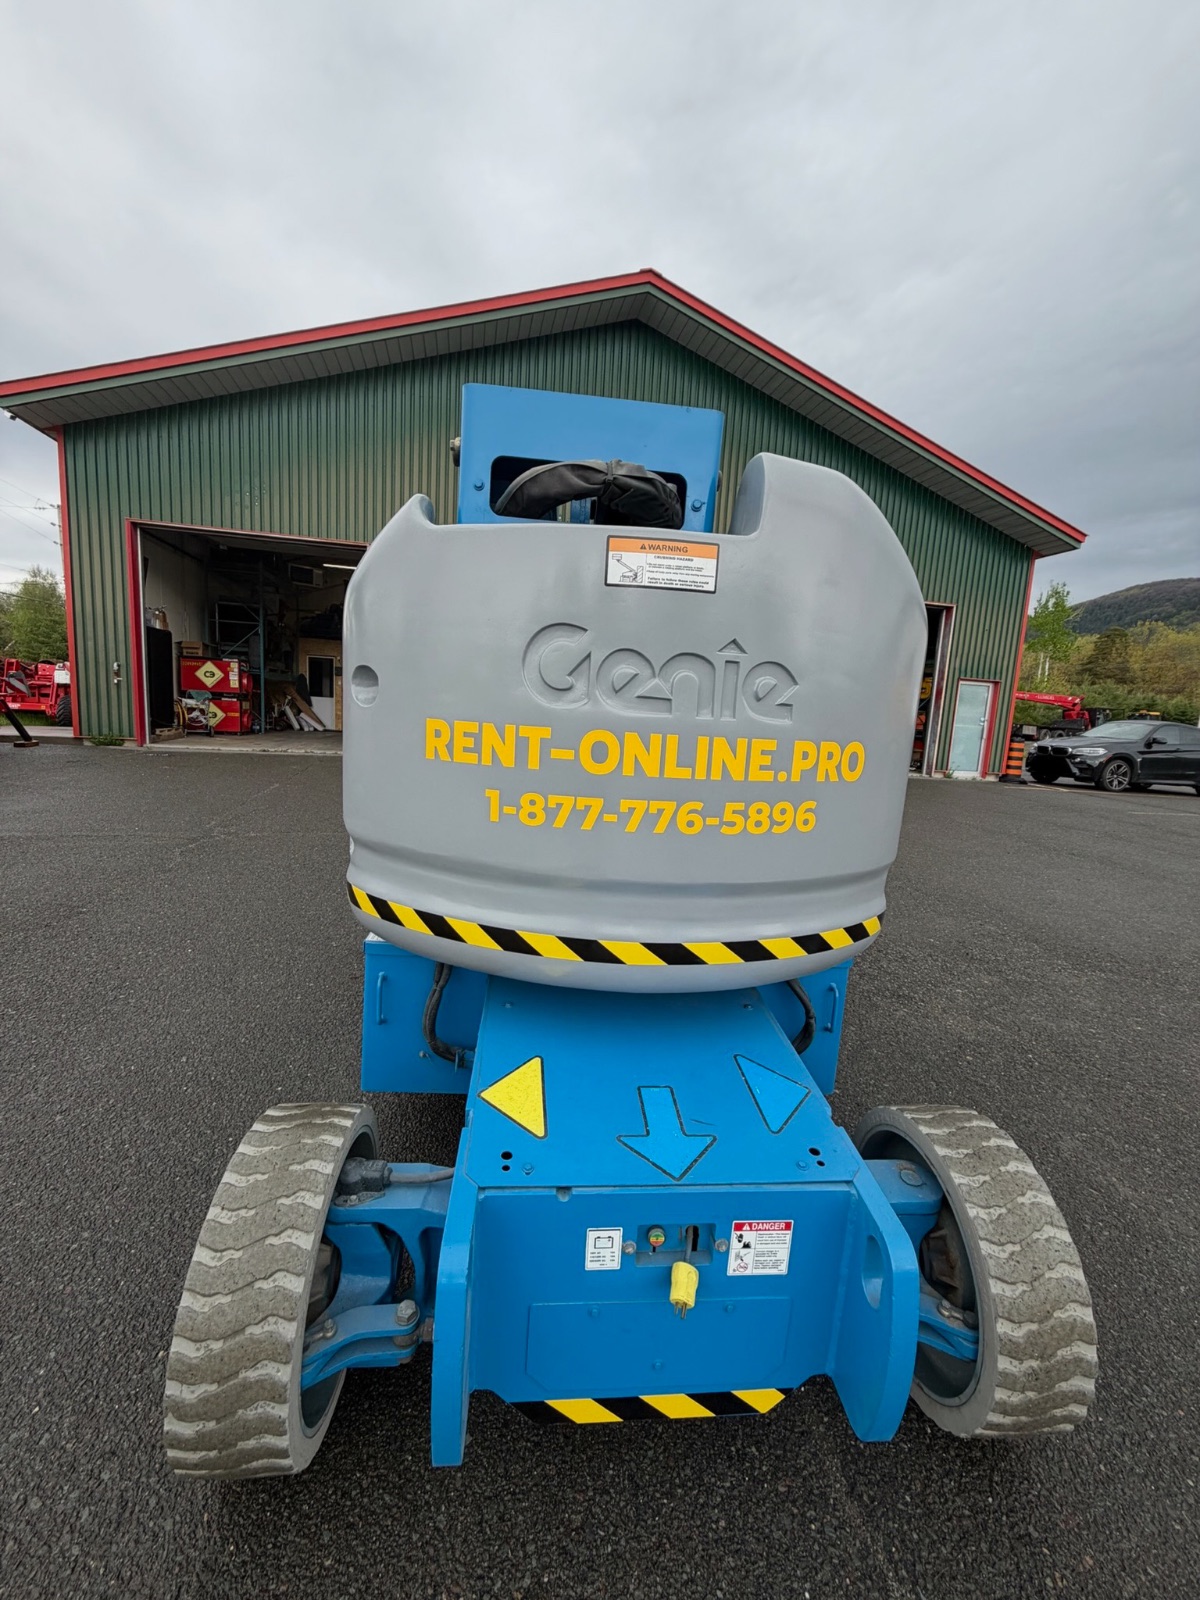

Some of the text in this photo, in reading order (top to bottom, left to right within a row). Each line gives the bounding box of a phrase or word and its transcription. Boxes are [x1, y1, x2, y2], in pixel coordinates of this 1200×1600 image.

[648, 543, 689, 553] WARNING
[521, 621, 800, 725] Genie
[424, 718, 866, 783] RENT-ONLINE.PRO
[484, 788, 818, 836] 1-877-776-5896
[751, 1222, 786, 1231] DANGER
